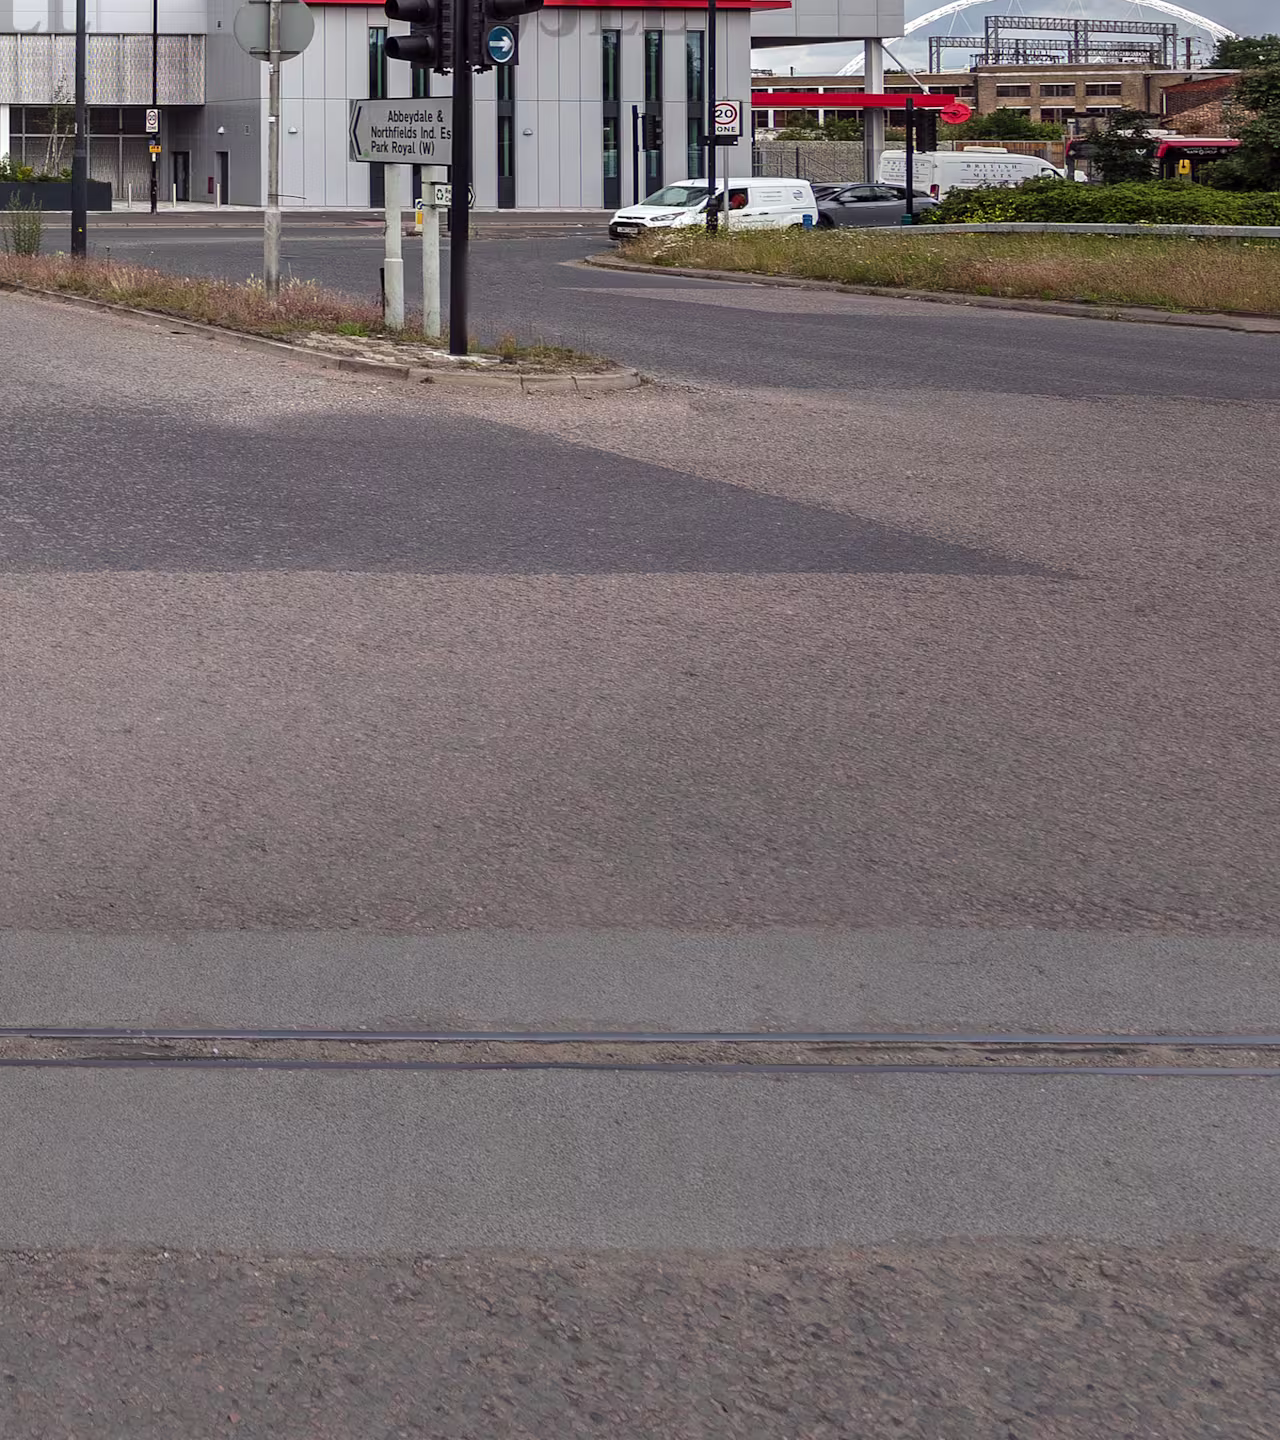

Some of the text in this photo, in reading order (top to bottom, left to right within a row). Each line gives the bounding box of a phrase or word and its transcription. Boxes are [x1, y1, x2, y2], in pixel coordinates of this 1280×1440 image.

[387, 110, 444, 125] Abbeydale &
[715, 109, 734, 118] 20
[371, 126, 452, 139] Northfields Ind. Es
[371, 141, 435, 156] Park Royal (W)
